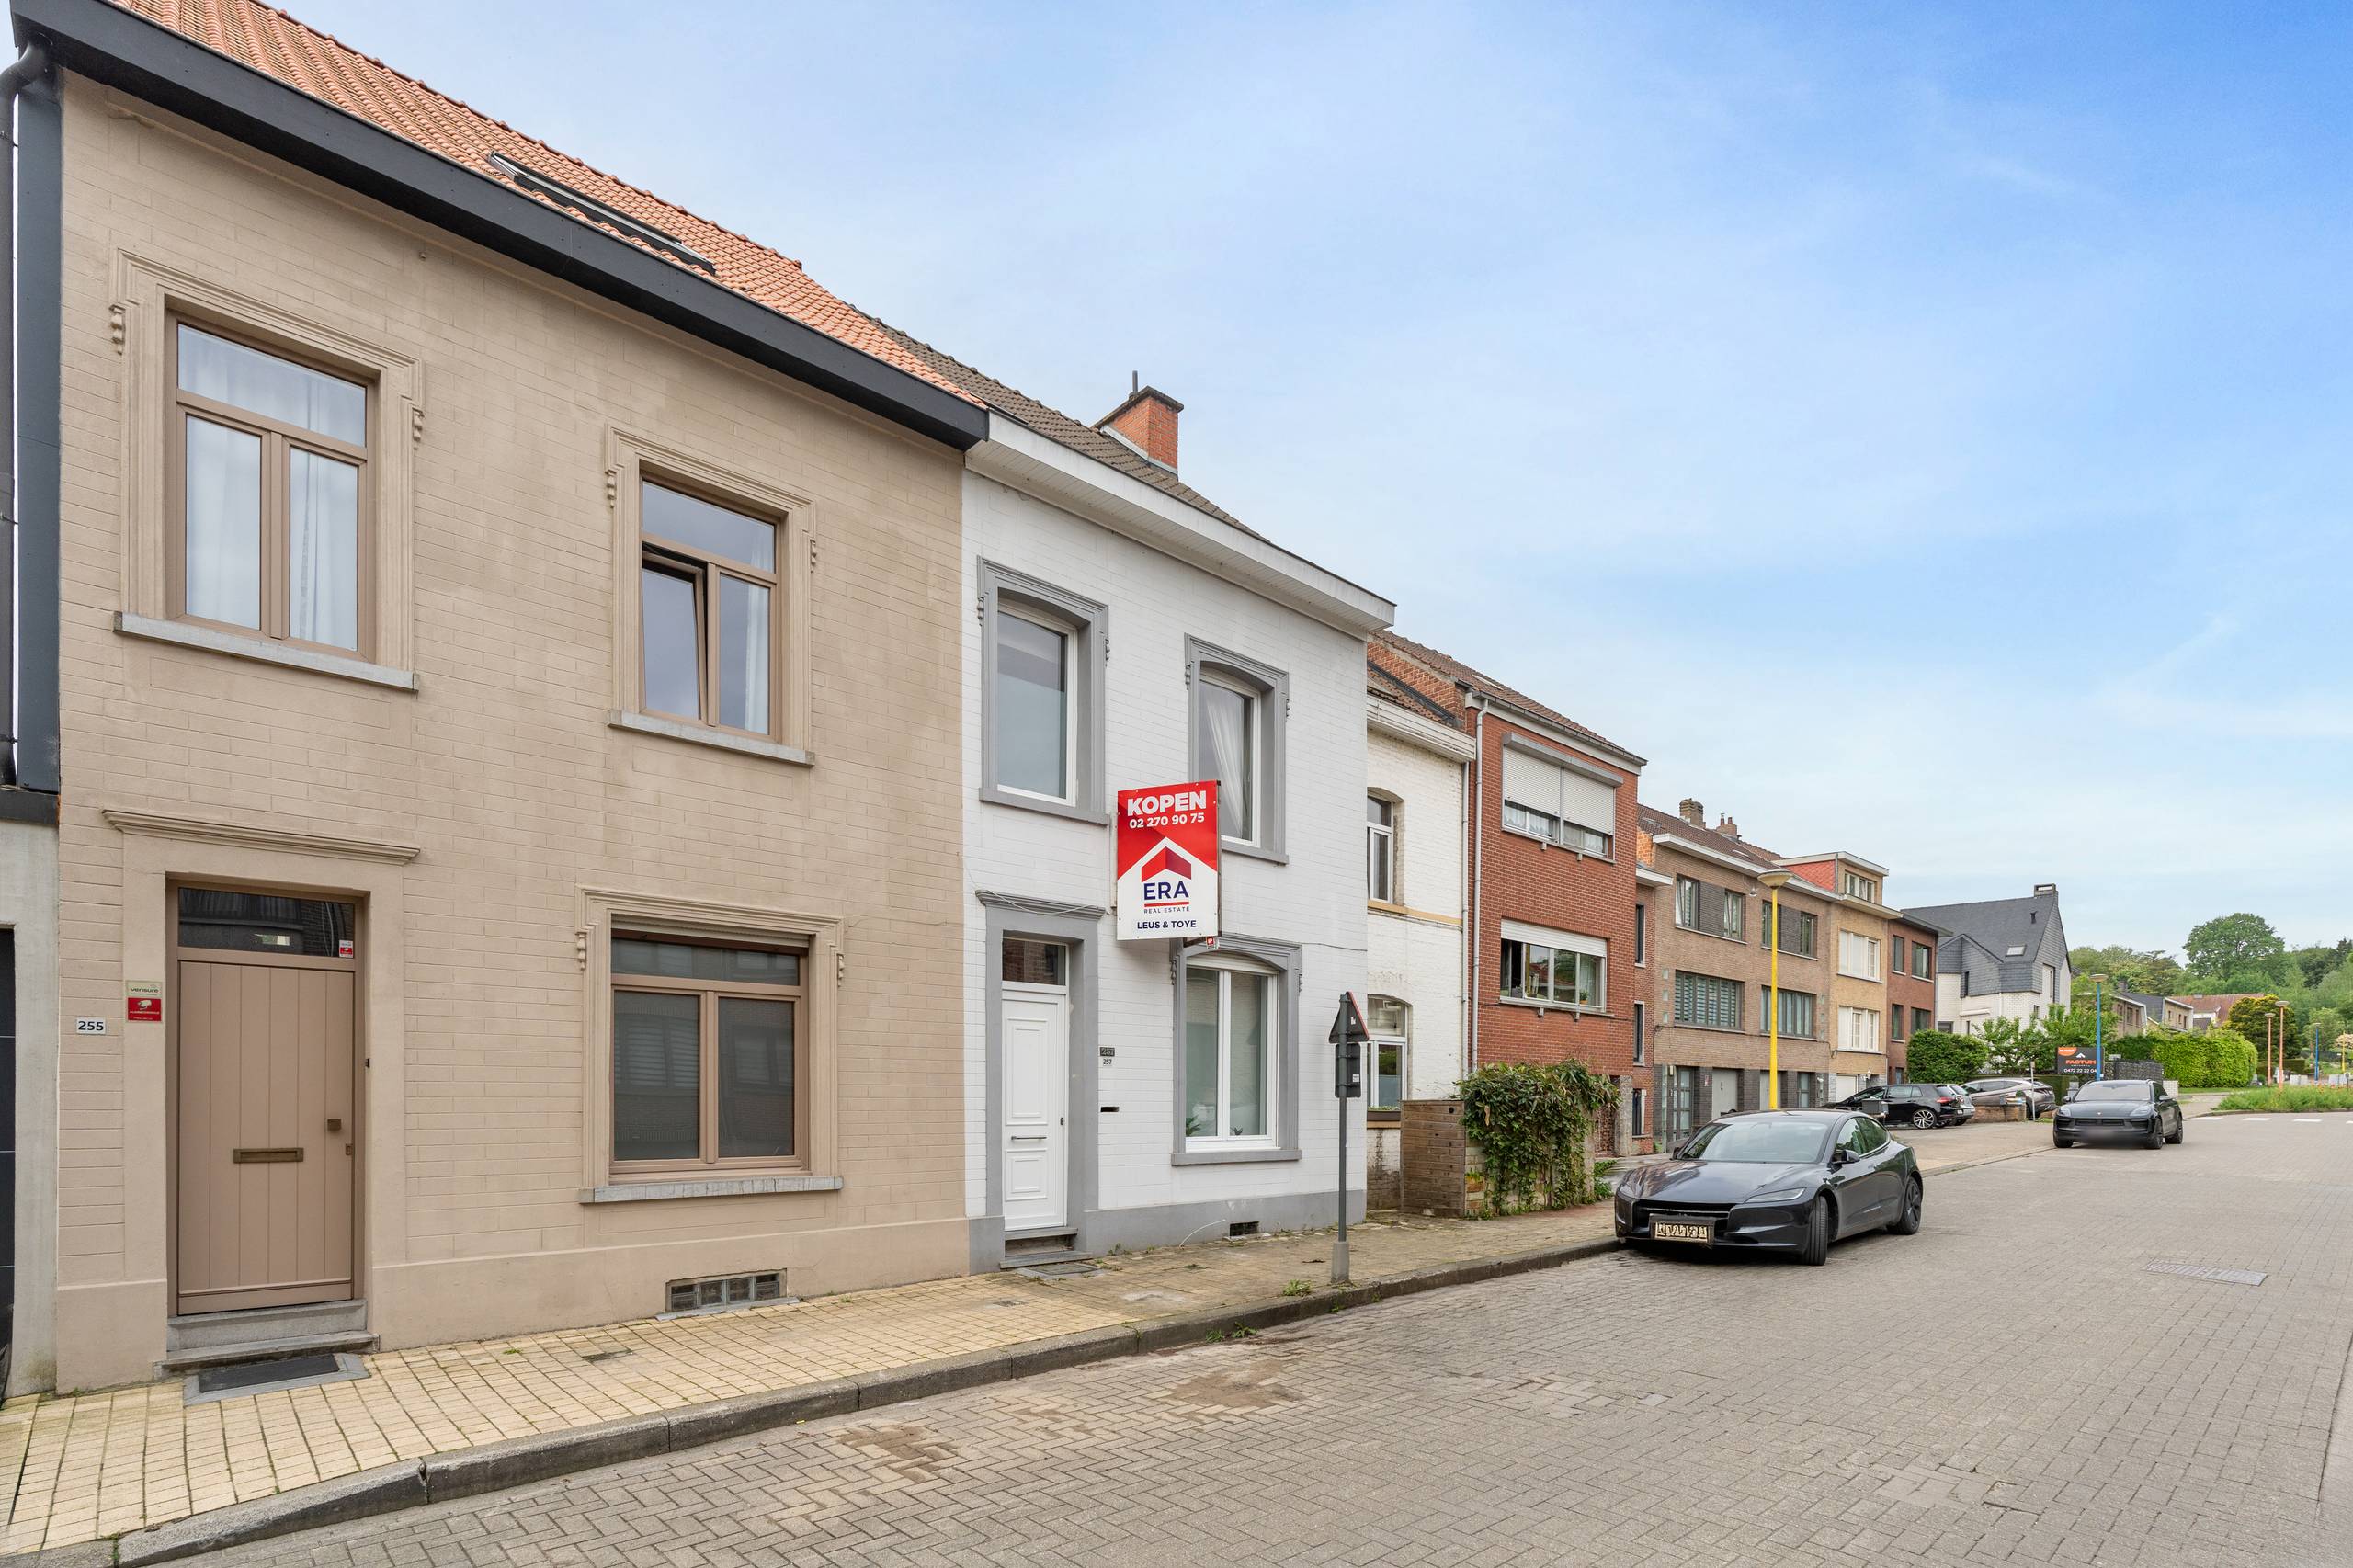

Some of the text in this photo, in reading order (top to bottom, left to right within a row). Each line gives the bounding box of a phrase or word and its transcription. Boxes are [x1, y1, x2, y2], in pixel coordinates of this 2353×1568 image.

[1127, 790, 1207, 817] KOPEN
[1129, 812, 1205, 829] 02 270 90 75
[1143, 881, 1189, 901] ERA
[1137, 921, 1161, 929] LEUS
[1170, 920, 1197, 928] TOYE
[78, 1020, 104, 1031] 255
